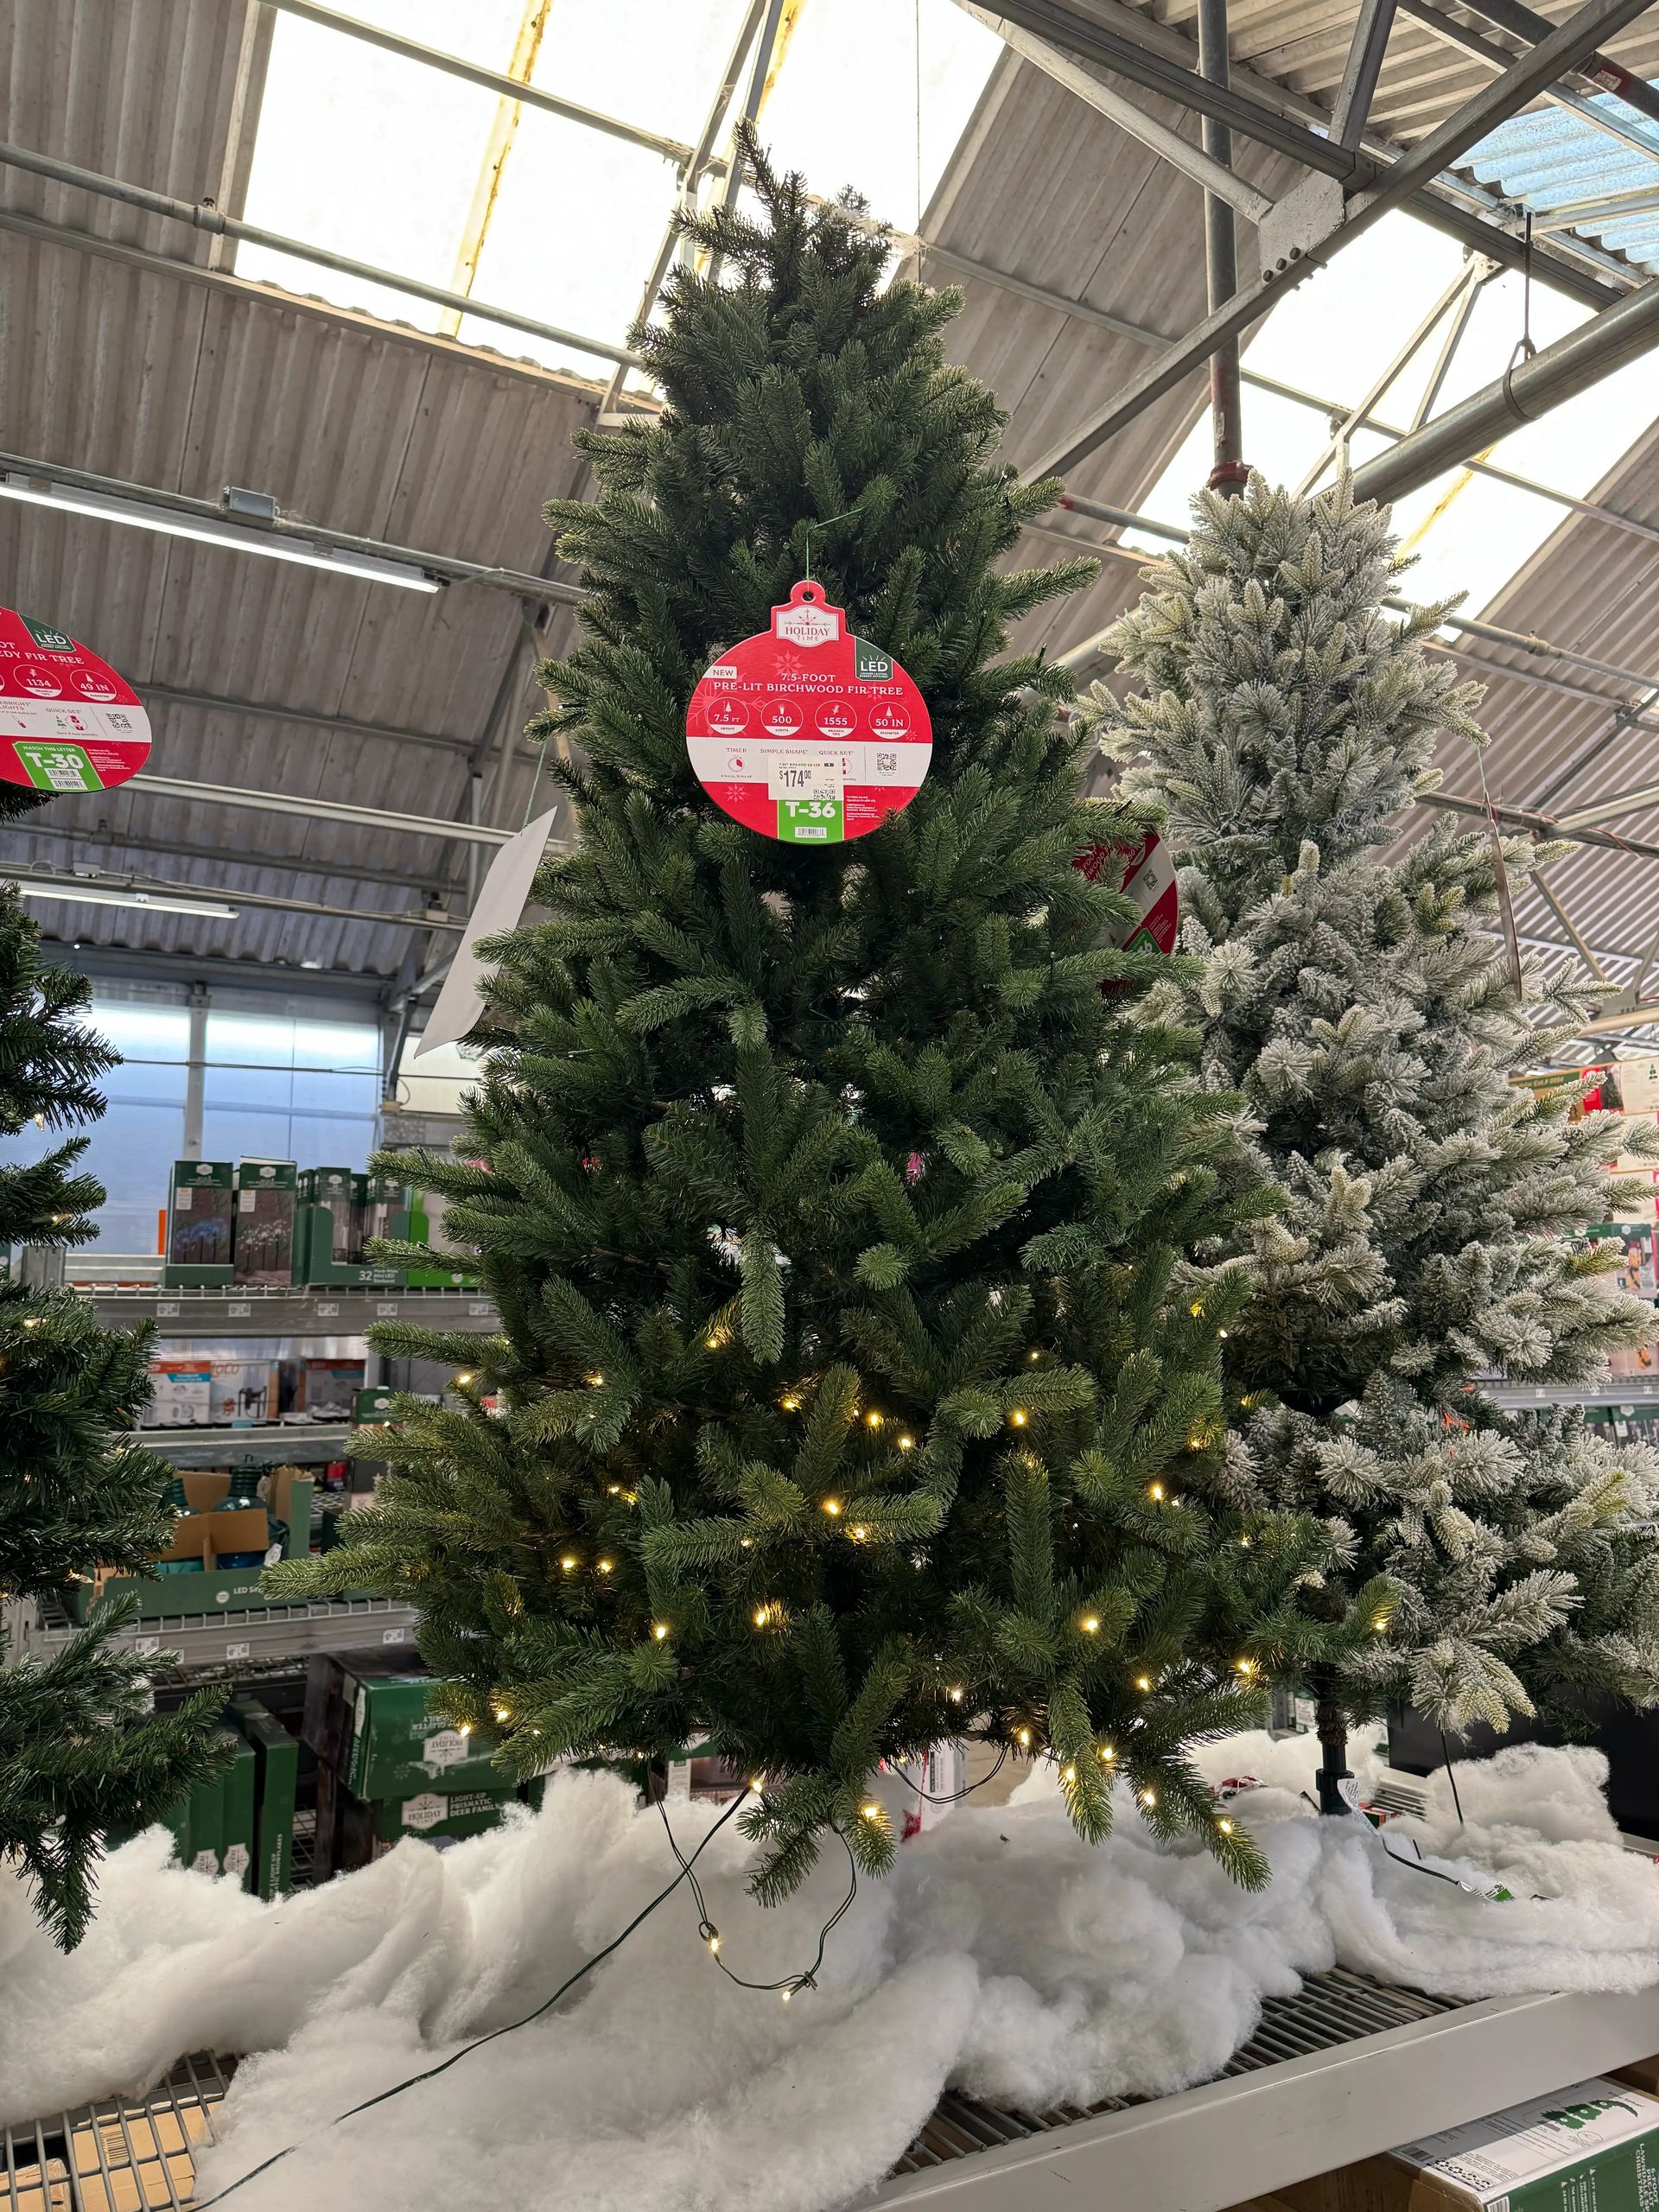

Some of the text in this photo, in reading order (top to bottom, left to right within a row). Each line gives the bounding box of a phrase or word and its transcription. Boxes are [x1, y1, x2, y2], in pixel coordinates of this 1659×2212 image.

[785, 626, 830, 636] HOLIDAY
[35, 633, 67, 645] LED
[25, 652, 48, 661] FIR
[49, 654, 84, 664] TREE
[861, 661, 888, 672] LED
[26, 678, 52, 688] 1134
[781, 673, 836, 683] 7.5-FOOT
[79, 683, 110, 692] 49 IN
[714, 682, 903, 696] PRE-LIT BIRCHWOOD FIR TREE
[714, 714, 729, 722] 7.5
[772, 715, 792, 724] 500
[823, 717, 848, 726] 1555
[892, 719, 904, 728] IN
[25, 752, 85, 769] T-30
[785, 801, 836, 819] T-36
[359, 1270, 372, 1281] 32
[233, 1586, 248, 1595] LED
[432, 1739, 463, 1749] HOLIDAY
[450, 1792, 487, 1803] LIGHT-UP
[450, 1798, 493, 1810] PRISMATIC
[408, 1810, 442, 1821] HOLIDAY
[450, 1808, 471, 1817] DEER
[1639, 2143, 1649, 2197] LAWNDALE
[1636, 2149, 1645, 2207] CHRISTMAS
